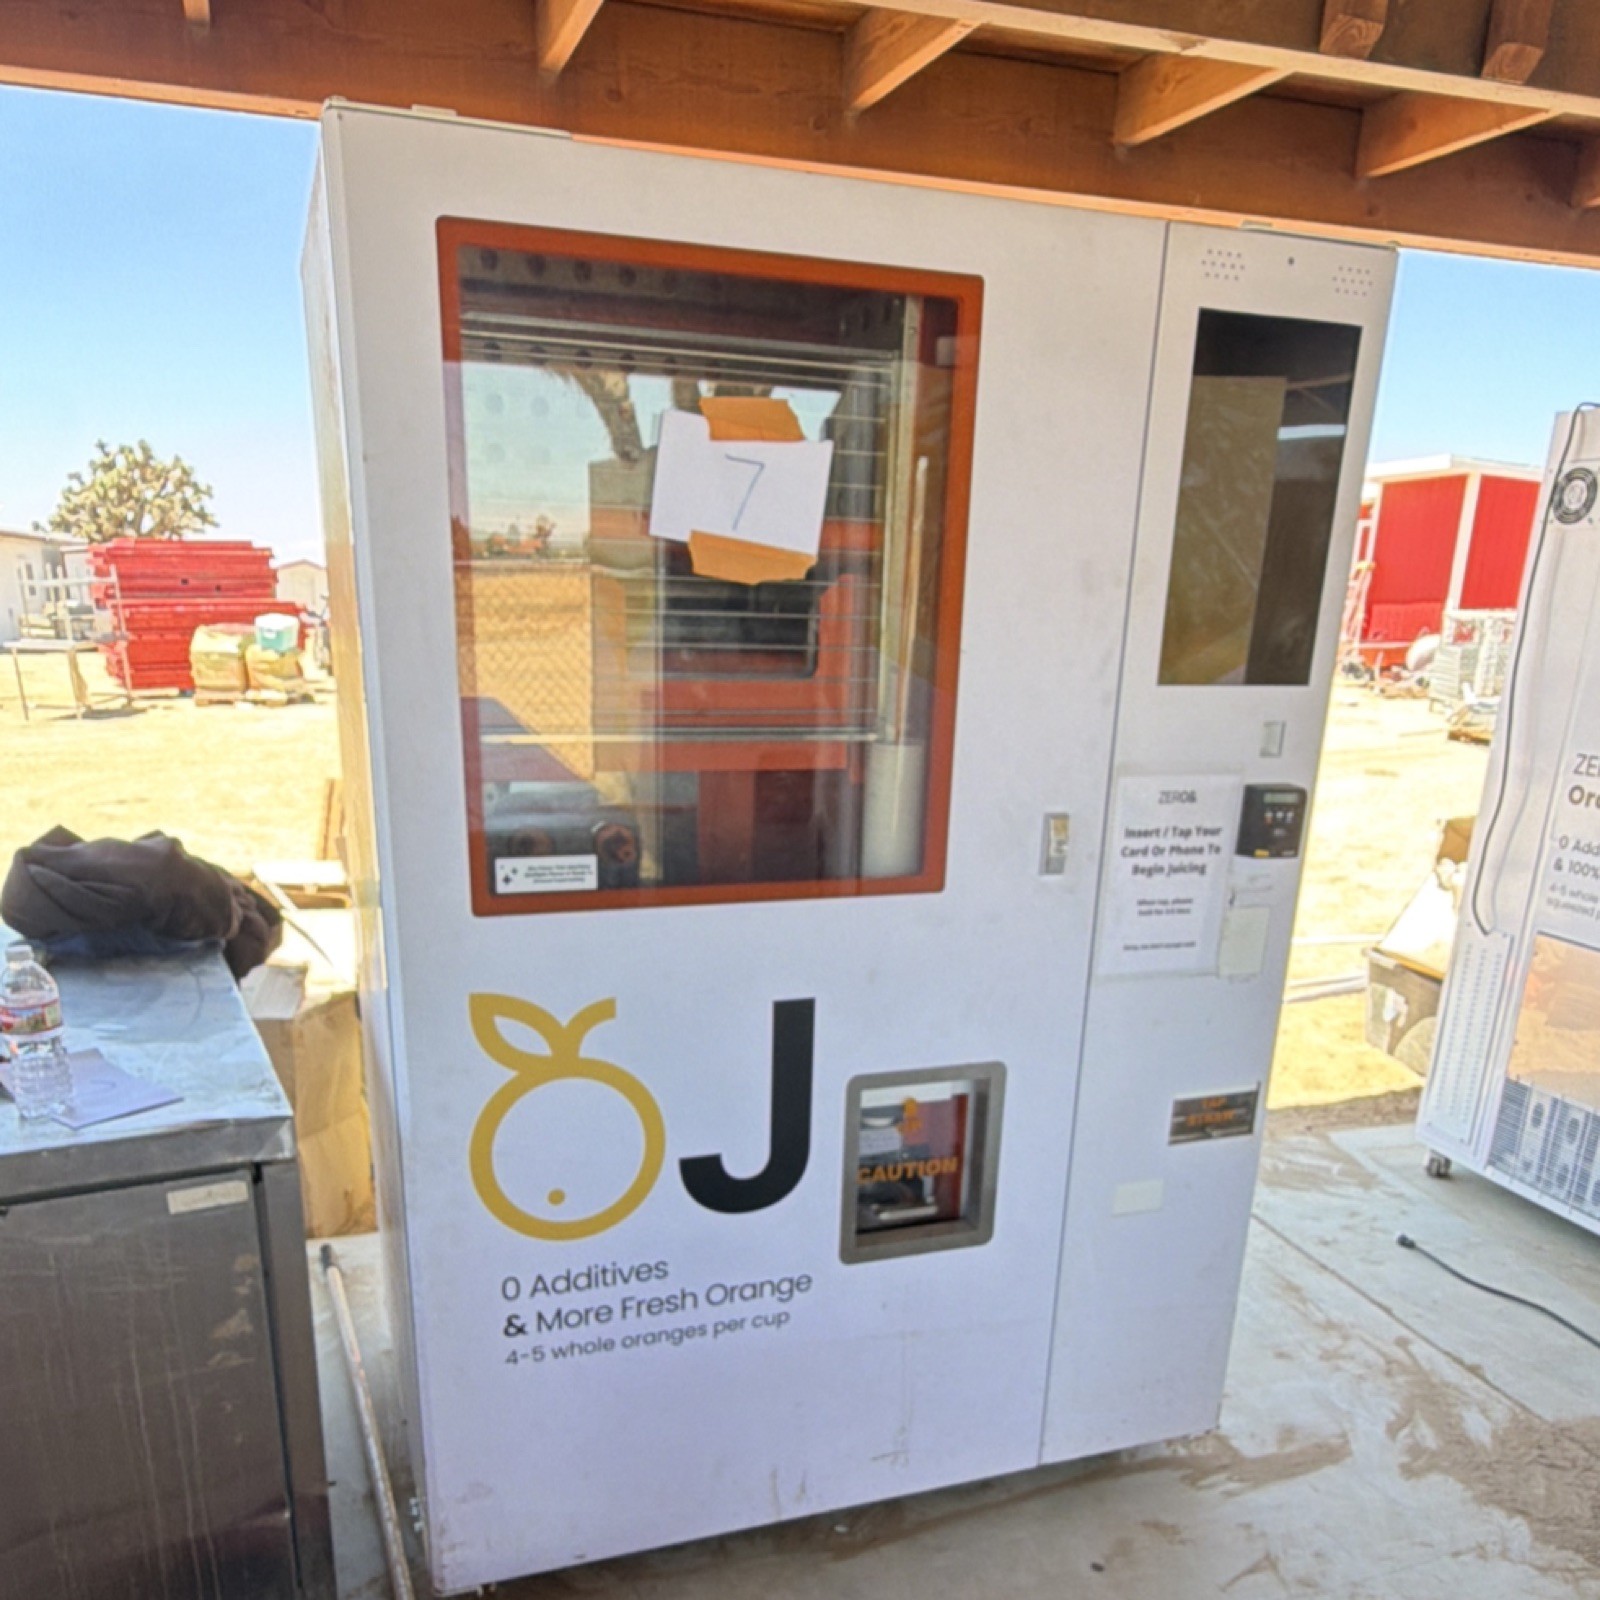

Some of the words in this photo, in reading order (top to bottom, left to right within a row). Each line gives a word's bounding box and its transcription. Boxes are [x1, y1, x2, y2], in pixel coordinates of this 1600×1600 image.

[724, 453, 766, 532] 7
[1573, 753, 1600, 777] ZE
[1124, 826, 1160, 838] Insert
[1172, 826, 1192, 840] Tap
[1195, 826, 1222, 837] Your
[1120, 845, 1149, 857] Card
[1151, 844, 1165, 856] Or
[1169, 844, 1204, 856] Phone
[1208, 842, 1222, 854] To
[1131, 863, 1165, 878] Begin
[856, 1157, 958, 1184] CAUTION
[529, 1260, 669, 1298] Additives
[503, 1313, 528, 1338] &
[536, 1304, 613, 1333] More
[620, 1287, 698, 1320] Fresh
[705, 1273, 813, 1307] Orange
[505, 1345, 546, 1366] 4-5
[550, 1336, 616, 1359] whole
[620, 1324, 708, 1346] oranges
[712, 1317, 747, 1340] per
[751, 1311, 791, 1329] cup
